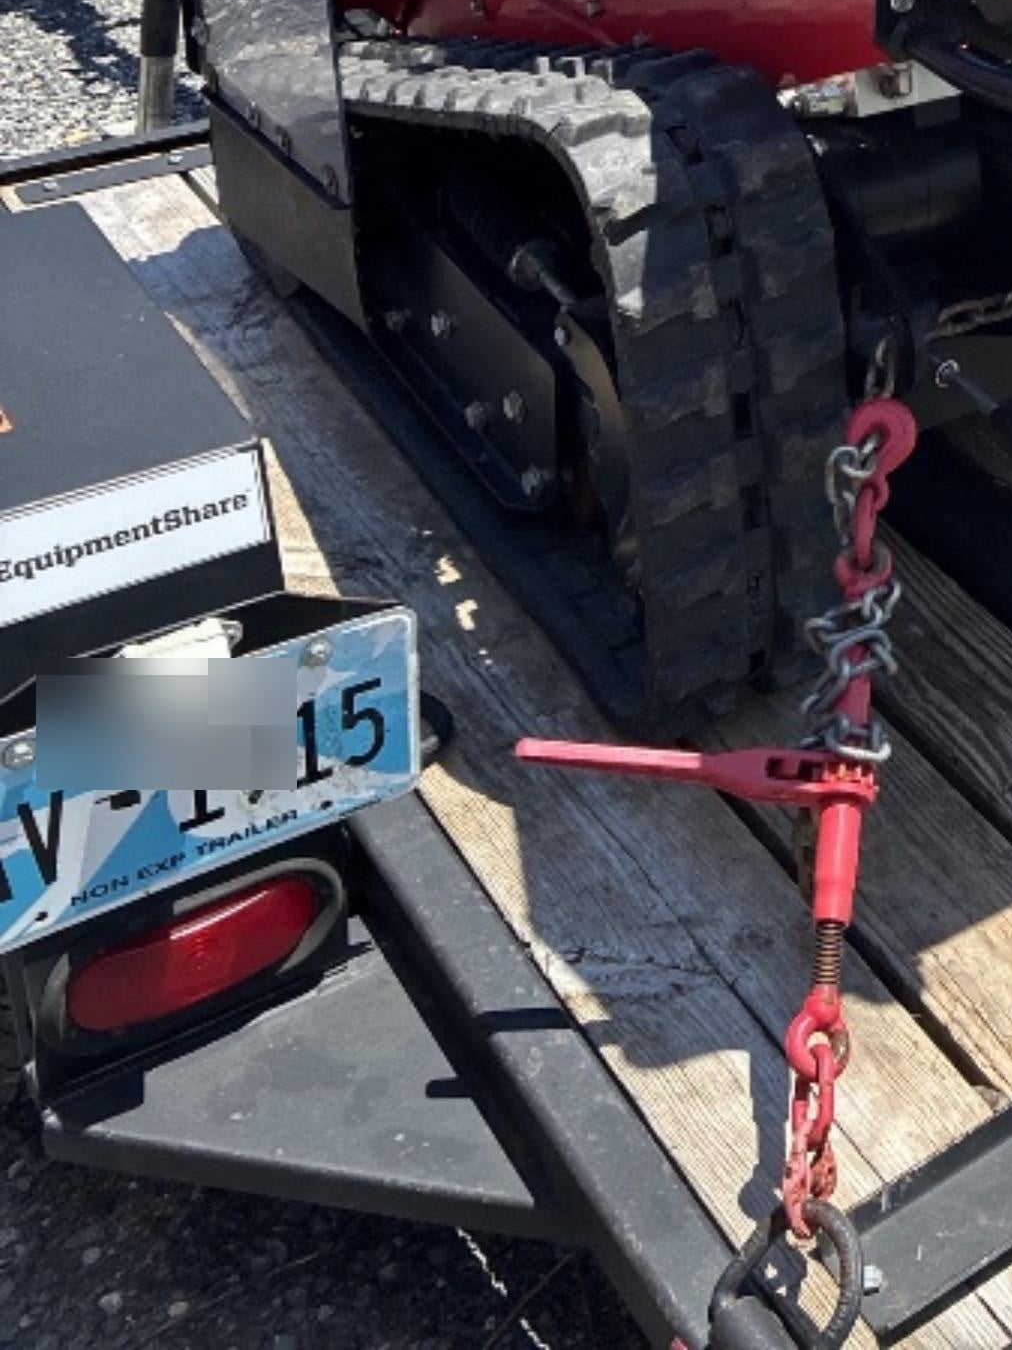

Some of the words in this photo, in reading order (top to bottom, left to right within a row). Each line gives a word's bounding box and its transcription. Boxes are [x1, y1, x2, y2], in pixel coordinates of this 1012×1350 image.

[0, 493, 249, 583] EquipmentShare
[71, 874, 130, 907] NON
[137, 851, 187, 881] EXP
[195, 809, 298, 856] TRAILER
